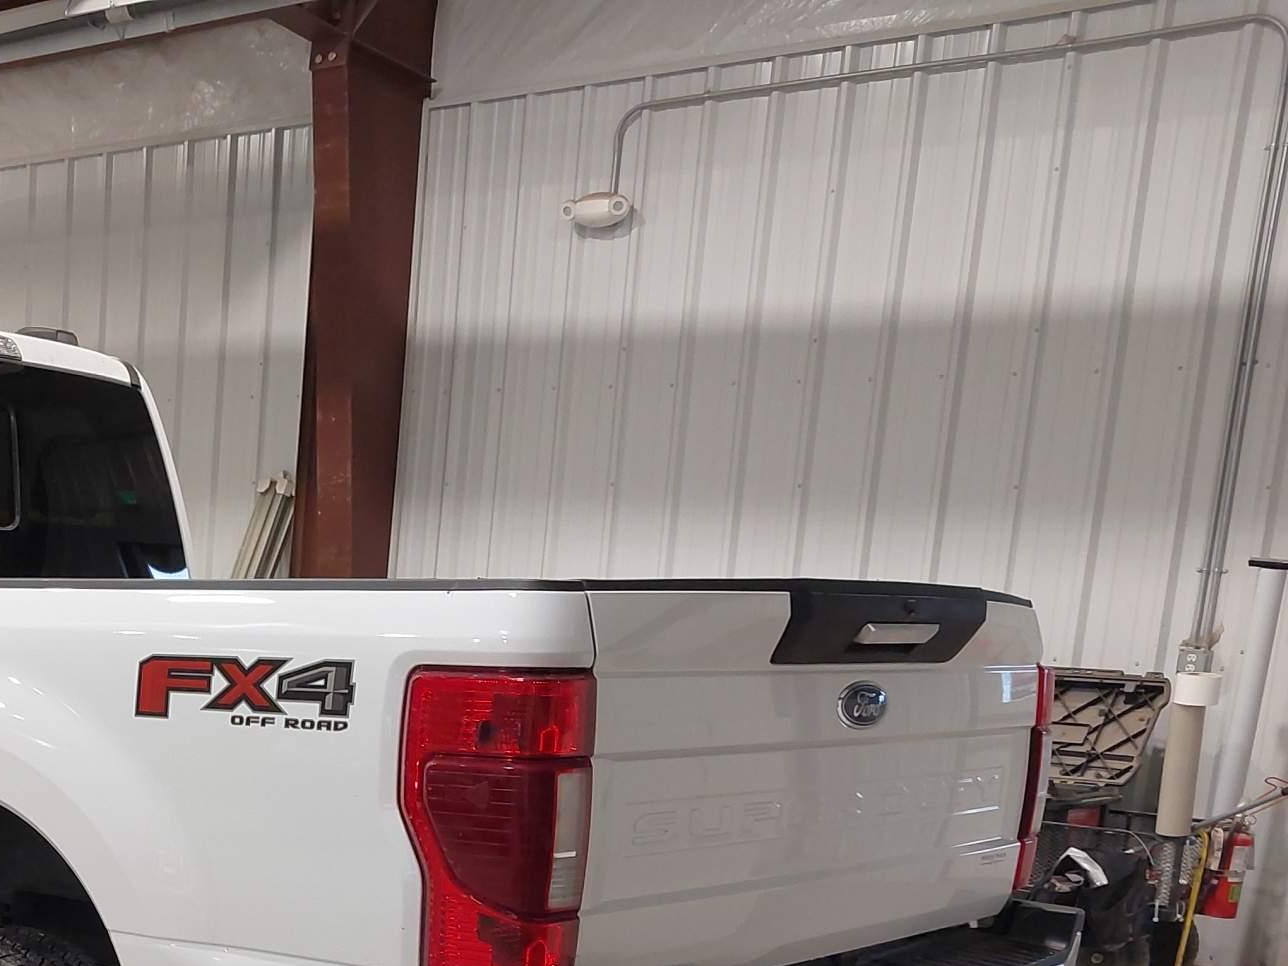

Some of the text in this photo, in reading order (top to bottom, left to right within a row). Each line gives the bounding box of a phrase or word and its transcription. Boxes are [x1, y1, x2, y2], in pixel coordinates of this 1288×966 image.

[134, 653, 356, 719] FX4
[853, 691, 883, 717] Ford
[230, 715, 349, 732] OFF ROAD
